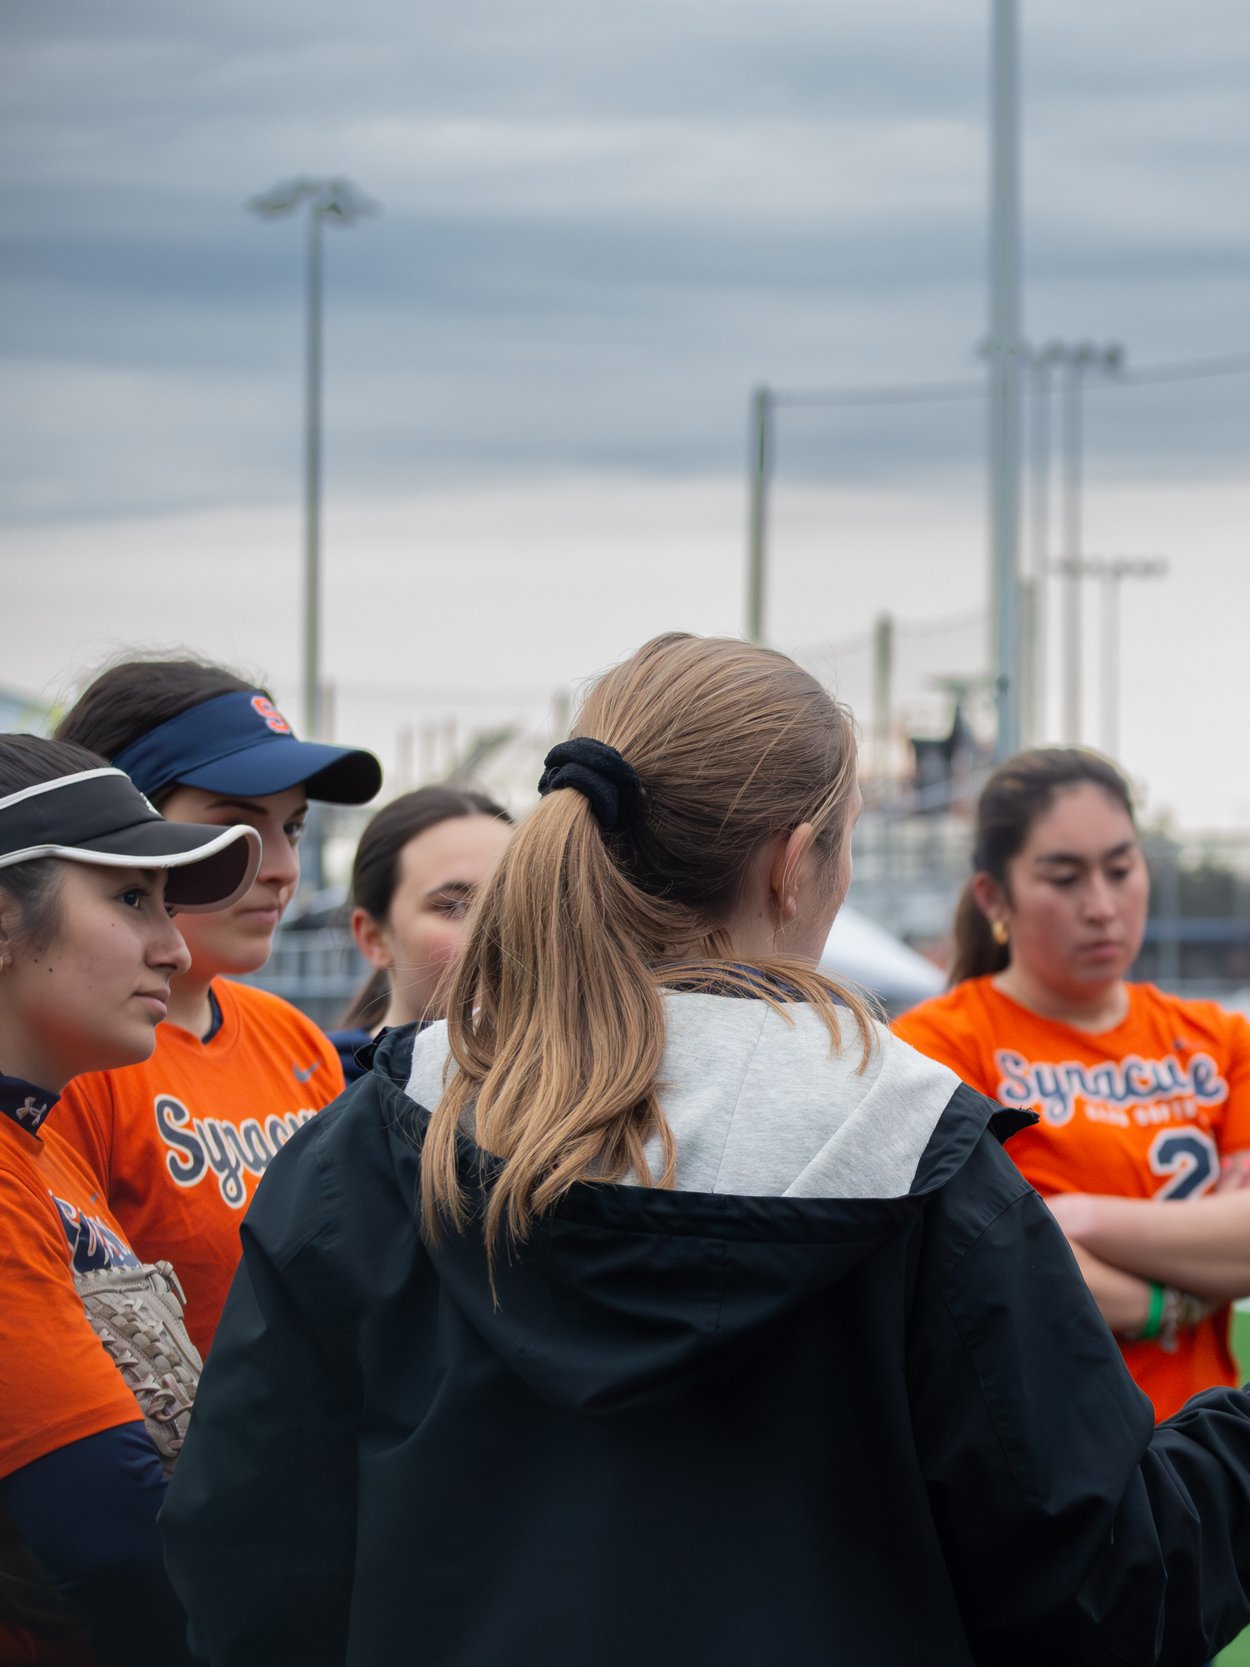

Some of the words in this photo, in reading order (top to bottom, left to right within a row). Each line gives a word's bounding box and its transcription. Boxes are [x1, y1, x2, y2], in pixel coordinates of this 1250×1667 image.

[251, 696, 290, 735] S
[994, 1050, 1230, 1127] Syracue
[154, 1094, 318, 1209] Syrac
[1149, 1125, 1220, 1201] 2
